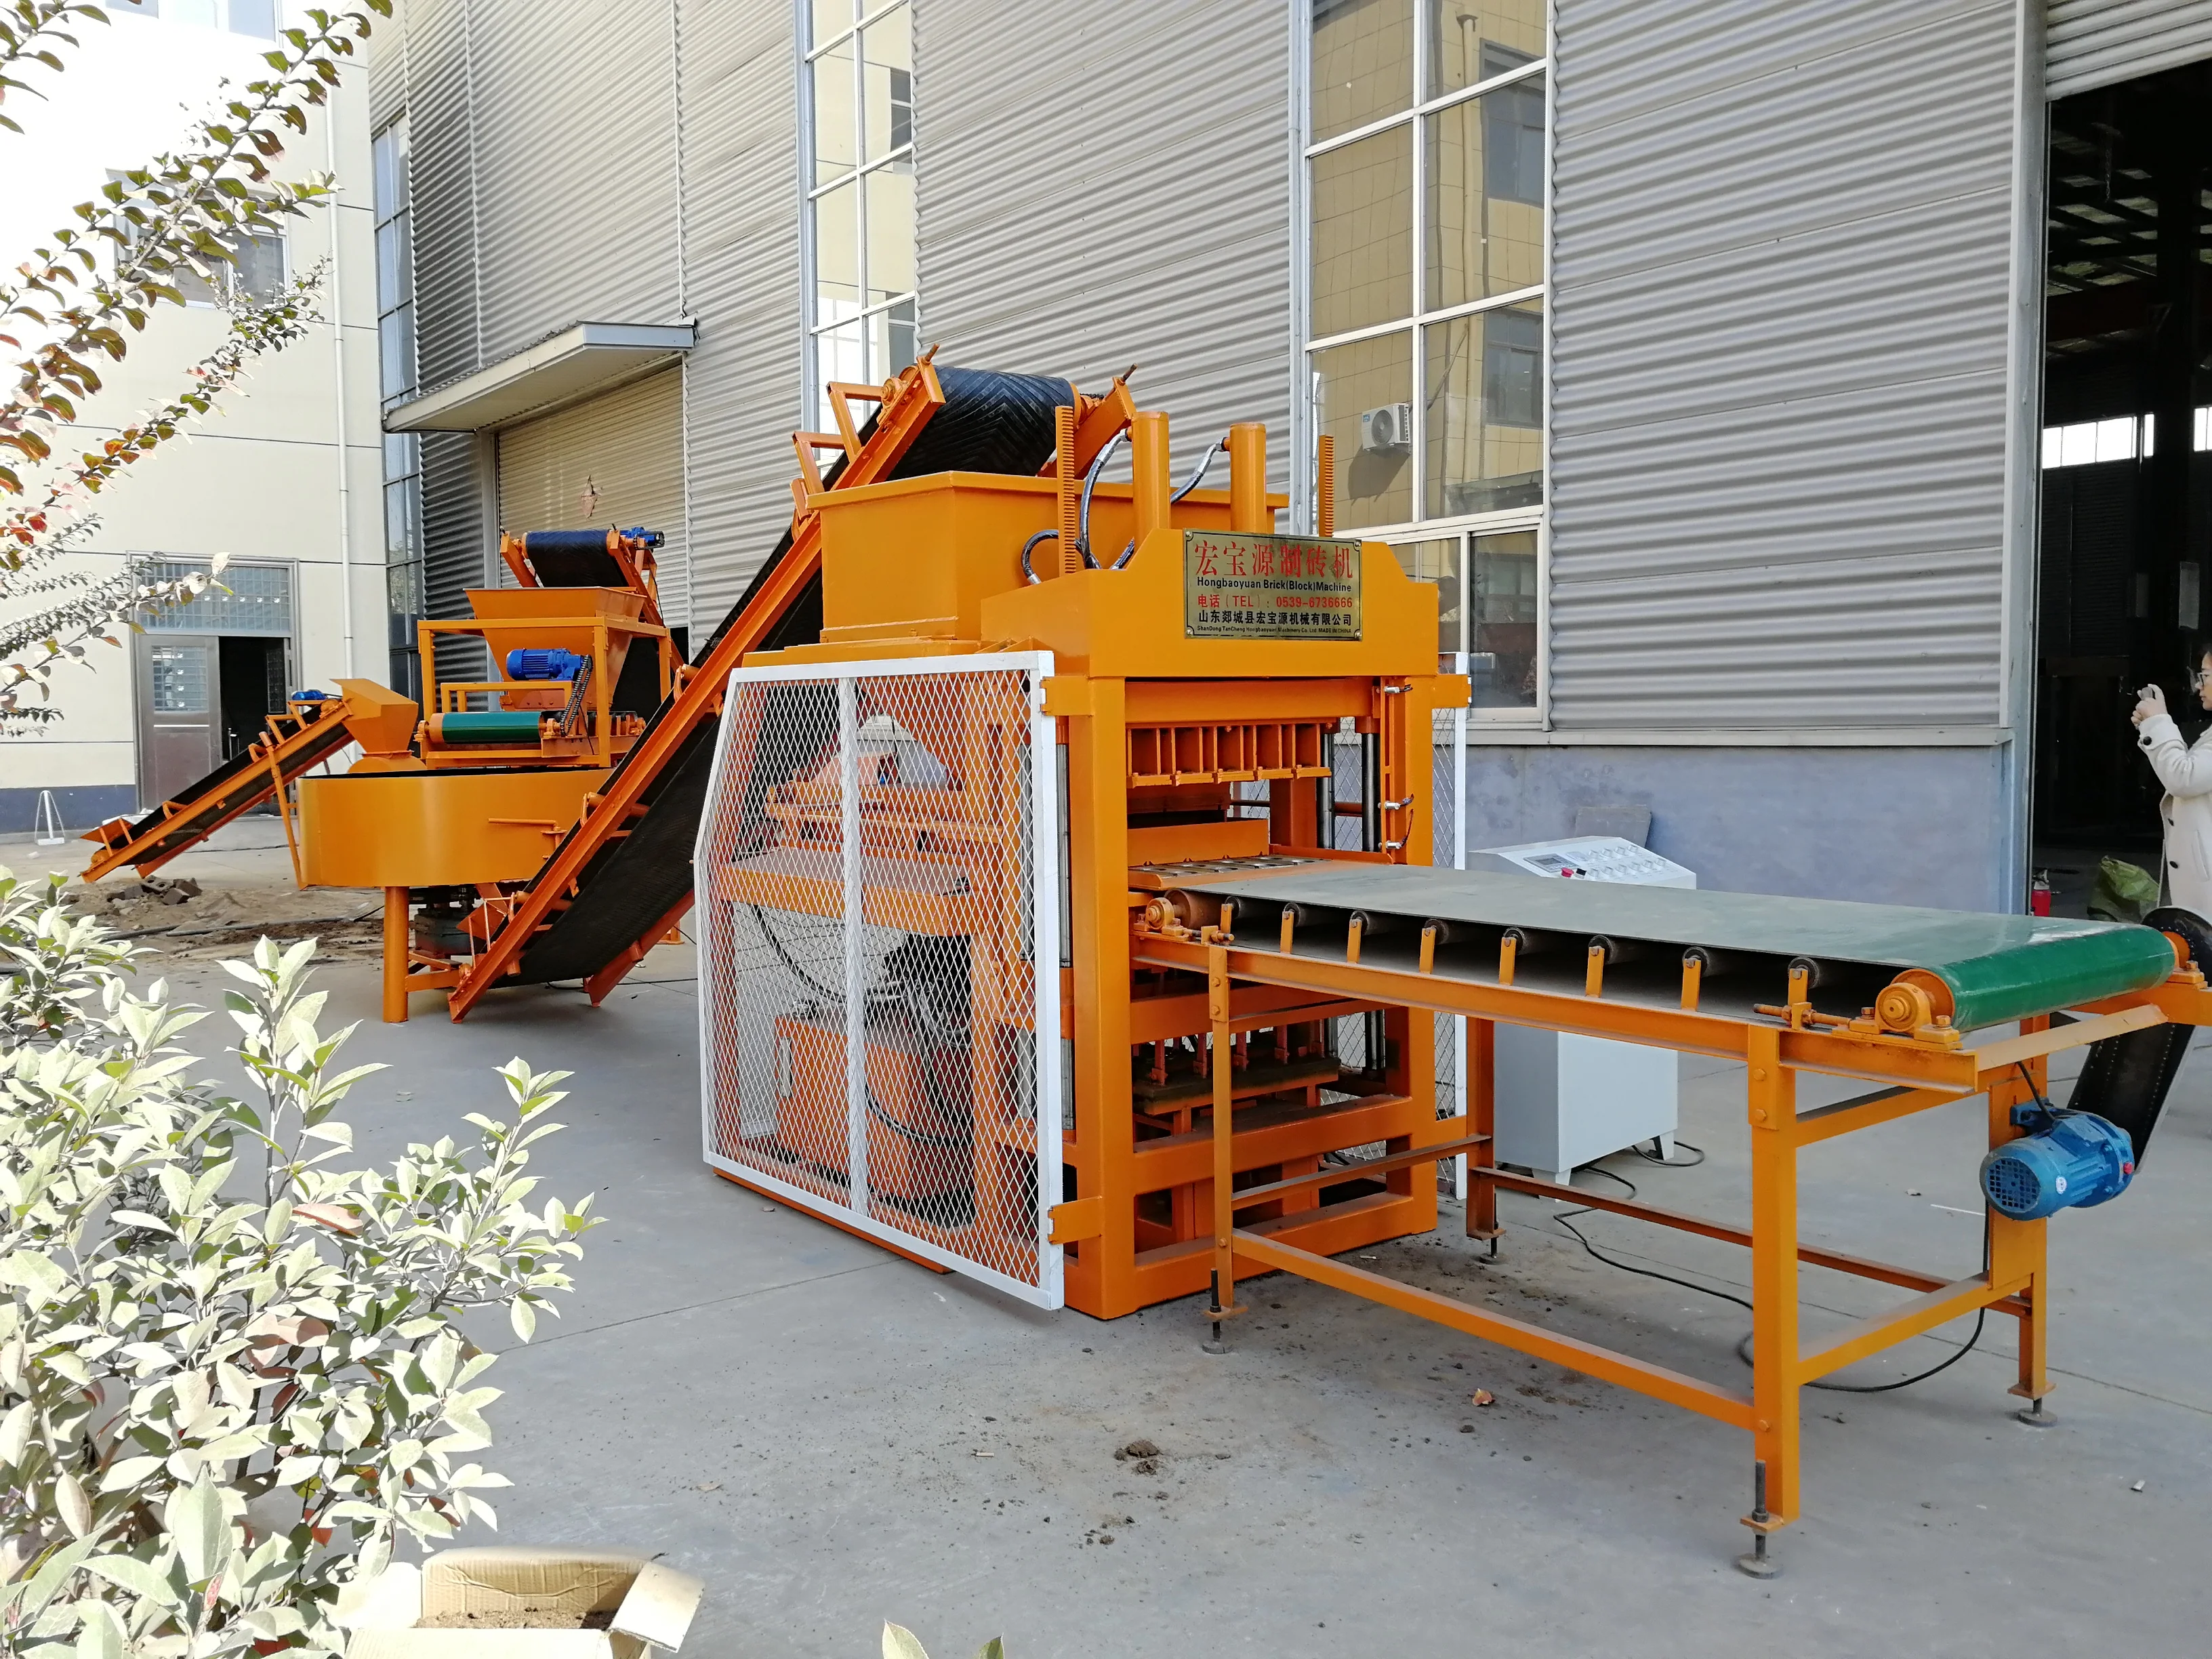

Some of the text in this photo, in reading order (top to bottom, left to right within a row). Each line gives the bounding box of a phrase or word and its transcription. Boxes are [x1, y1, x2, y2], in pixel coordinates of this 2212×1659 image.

[1195, 540, 1353, 579] 宏宝源制砖机
[1197, 577, 1261, 590] Hongbaoyuan
[1199, 610, 1351, 626] 山东郯城县宏宝源机械有限公司
